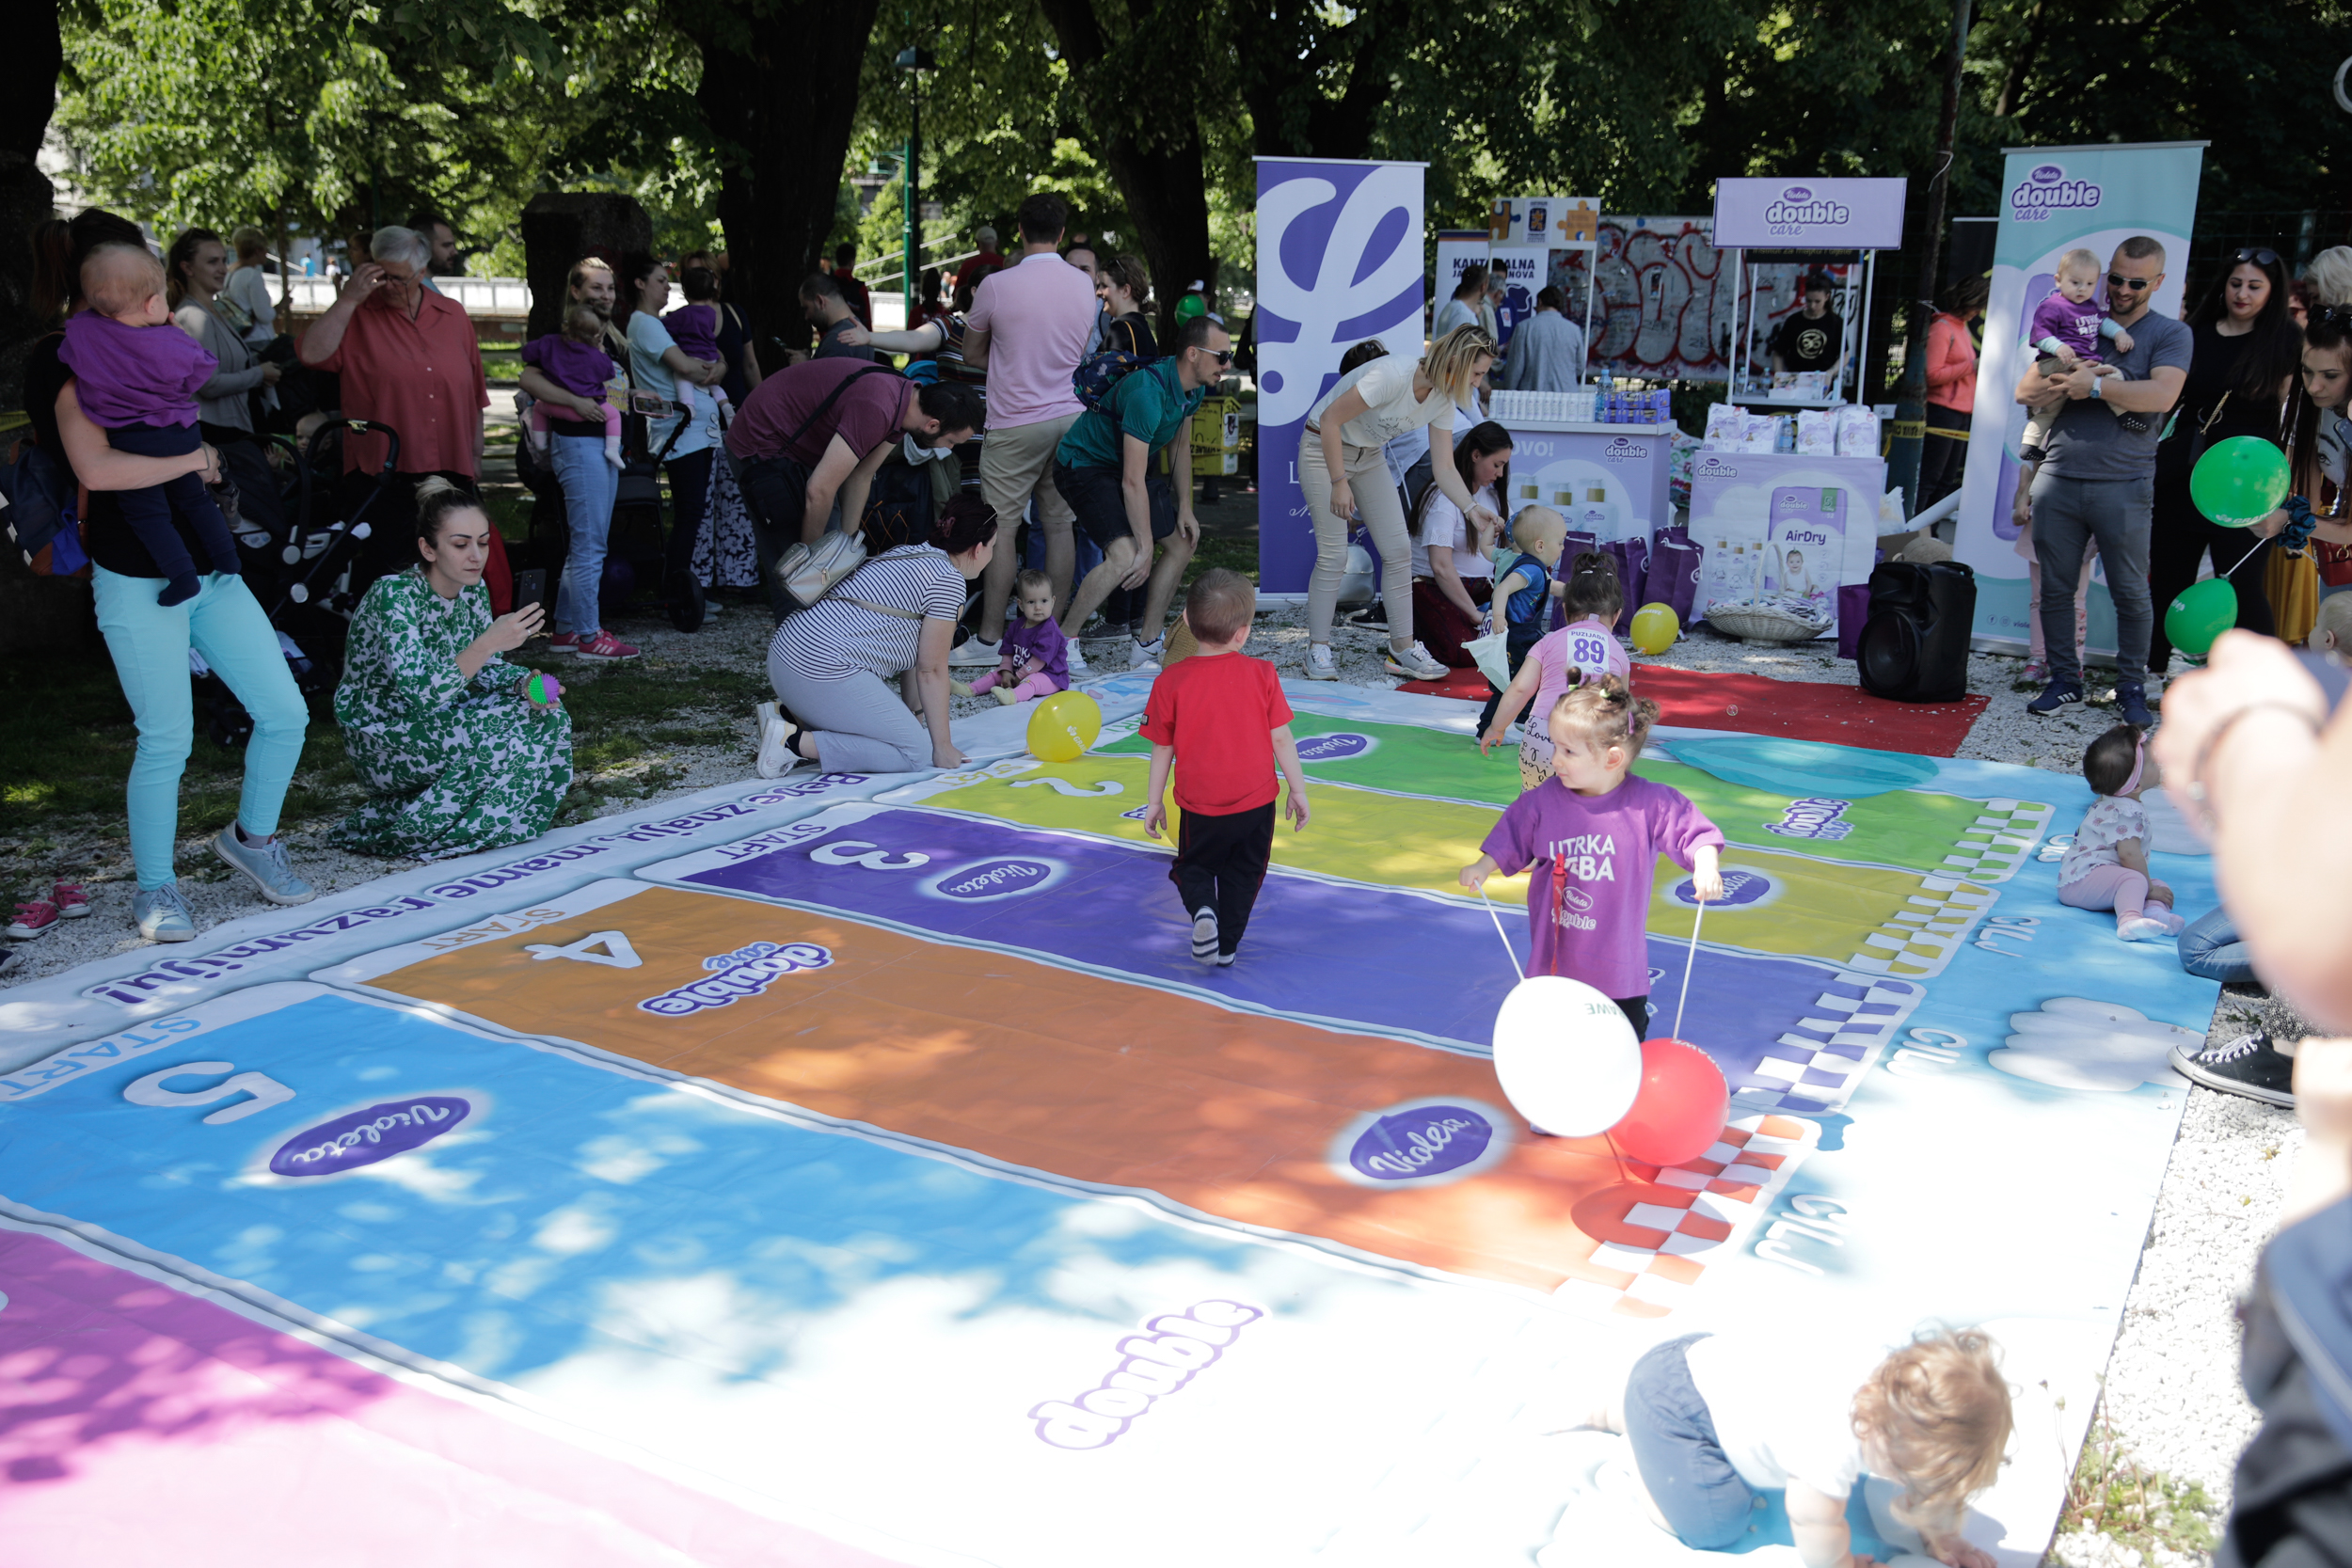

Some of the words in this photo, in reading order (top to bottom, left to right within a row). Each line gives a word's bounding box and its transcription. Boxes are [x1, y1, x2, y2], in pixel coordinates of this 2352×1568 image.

[2032, 169, 2059, 181] Violeta
[1785, 188, 1811, 200] Violeta
[2011, 180, 2102, 210] double
[1766, 200, 1850, 224] double
[2014, 207, 2051, 222] care
[1770, 224, 1804, 236] care
[1512, 440, 1554, 457] OVO!
[1605, 445, 1647, 458] double
[1698, 465, 1738, 478] double
[1779, 500, 1809, 510] double
[1823, 496, 1834, 508] 5
[1786, 530, 1827, 546] AirDry
[1570, 630, 1606, 642] PUZIJADA
[1573, 638, 1605, 664] 89
[1298, 737, 1358, 756] Violeta
[749, 773, 870, 805] Bebe
[1009, 777, 1124, 797] 2
[1762, 798, 1850, 837] double
[1820, 819, 1854, 840] care
[715, 823, 827, 860] START
[809, 840, 930, 870] 3
[1549, 833, 1616, 862] UTRKA
[432, 845, 610, 898] mame
[950, 862, 1038, 893] Violeta
[1565, 889, 1588, 908] Violeta
[421, 909, 566, 950] START
[1974, 915, 2042, 958] CILJ
[91, 896, 435, 1004] razumiju!
[524, 930, 644, 969] 4
[707, 942, 775, 970] care
[643, 942, 829, 1015] double
[0, 1016, 201, 1097] START
[1886, 1026, 1968, 1079] CILJ
[123, 1061, 296, 1125] 5
[293, 1104, 451, 1164] Violeta
[1368, 1117, 1471, 1173] Violeta
[1755, 1194, 1851, 1277] CILJ
[1026, 1298, 1264, 1451] double
